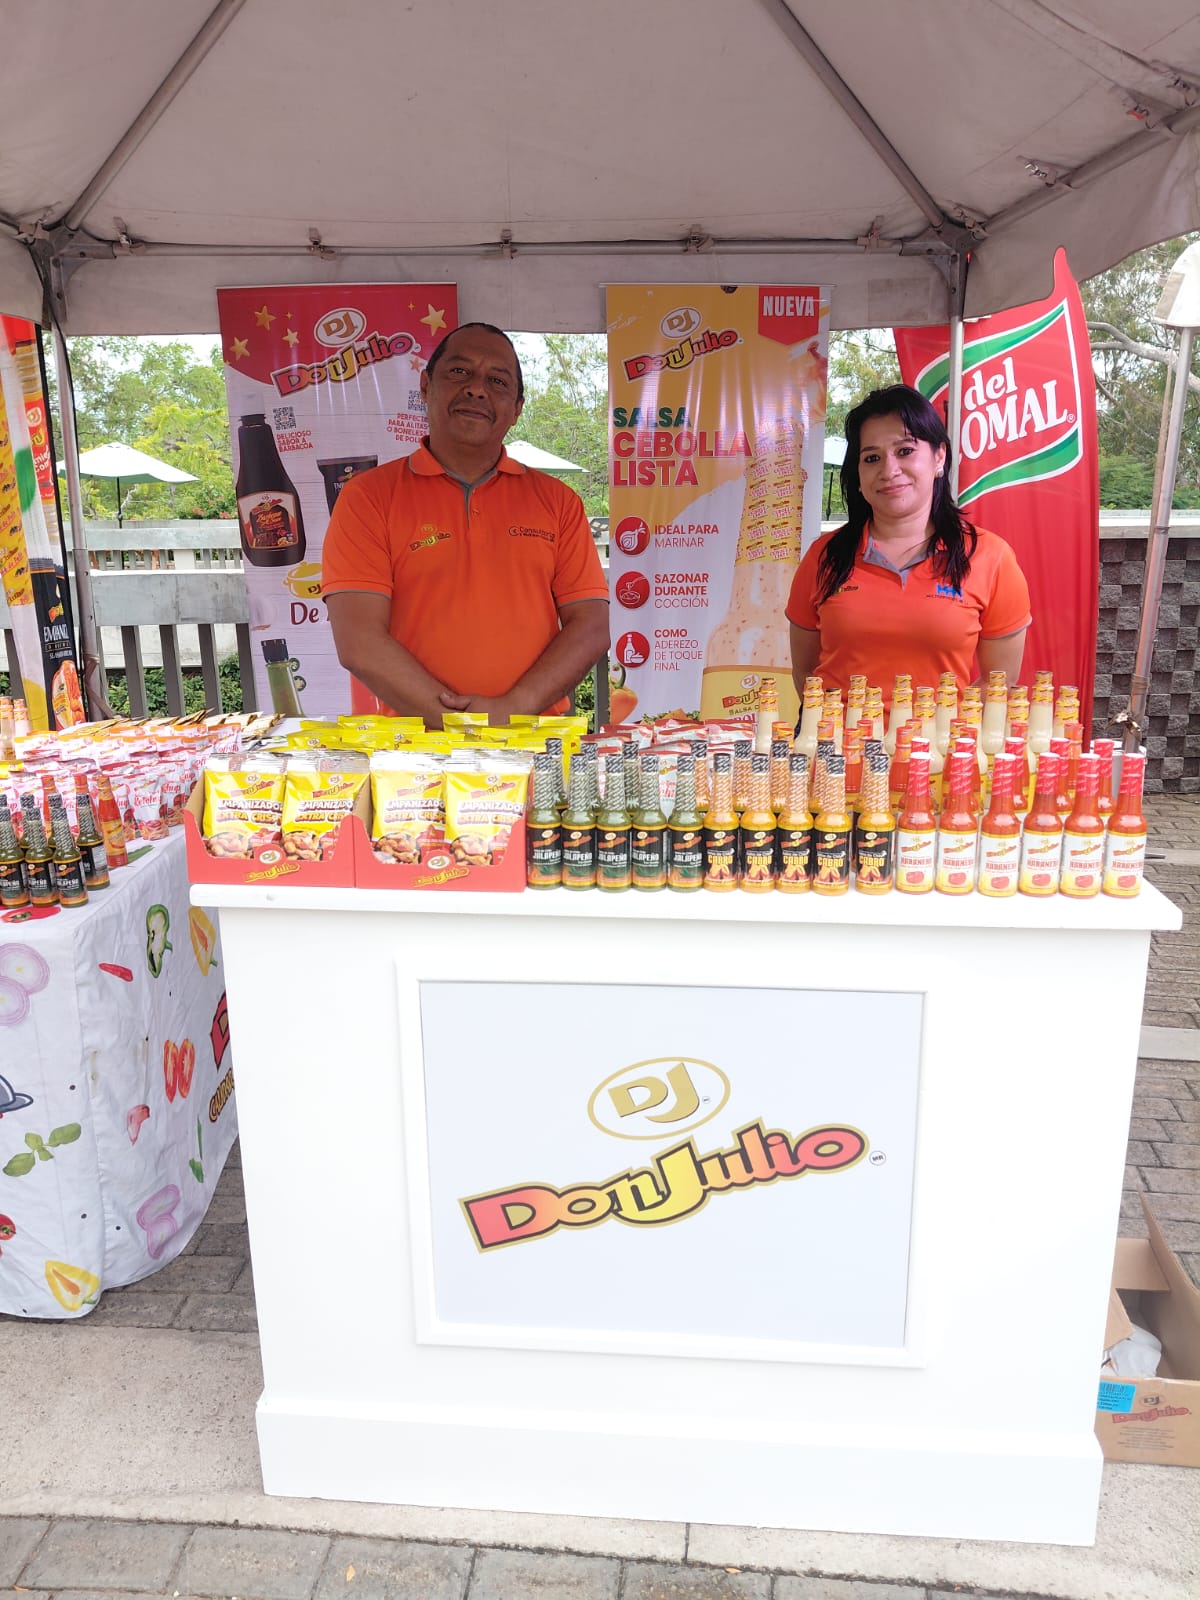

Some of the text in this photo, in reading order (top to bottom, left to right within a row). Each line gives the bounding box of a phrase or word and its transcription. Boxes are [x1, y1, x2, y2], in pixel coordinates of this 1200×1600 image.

[762, 295, 814, 317] NUEVA
[321, 311, 357, 338] DJ
[667, 309, 695, 333] DJ
[964, 356, 1018, 411] del
[613, 406, 692, 429] SALSA
[959, 380, 1067, 461] OMAL
[276, 430, 311, 441] DELICIOSO
[279, 442, 314, 452] BARBACOA
[613, 431, 753, 457] CEBOLLA
[613, 459, 699, 487] LISTA
[654, 524, 719, 535] IDEAL PARA
[654, 537, 704, 548] MARINAR
[654, 573, 709, 584] SAZONAR
[654, 586, 707, 596] DURANTE
[654, 596, 709, 609] COCCIÓN
[290, 602, 320, 626] De
[654, 629, 688, 638] COMO
[654, 640, 698, 649] ADEREZO
[654, 650, 703, 660] DE TOQUE
[654, 662, 680, 671] FINAL
[218, 799, 282, 813] EMPANIZADO
[459, 801, 523, 816] EMPANIZADO
[607, 1062, 701, 1124] DJ
